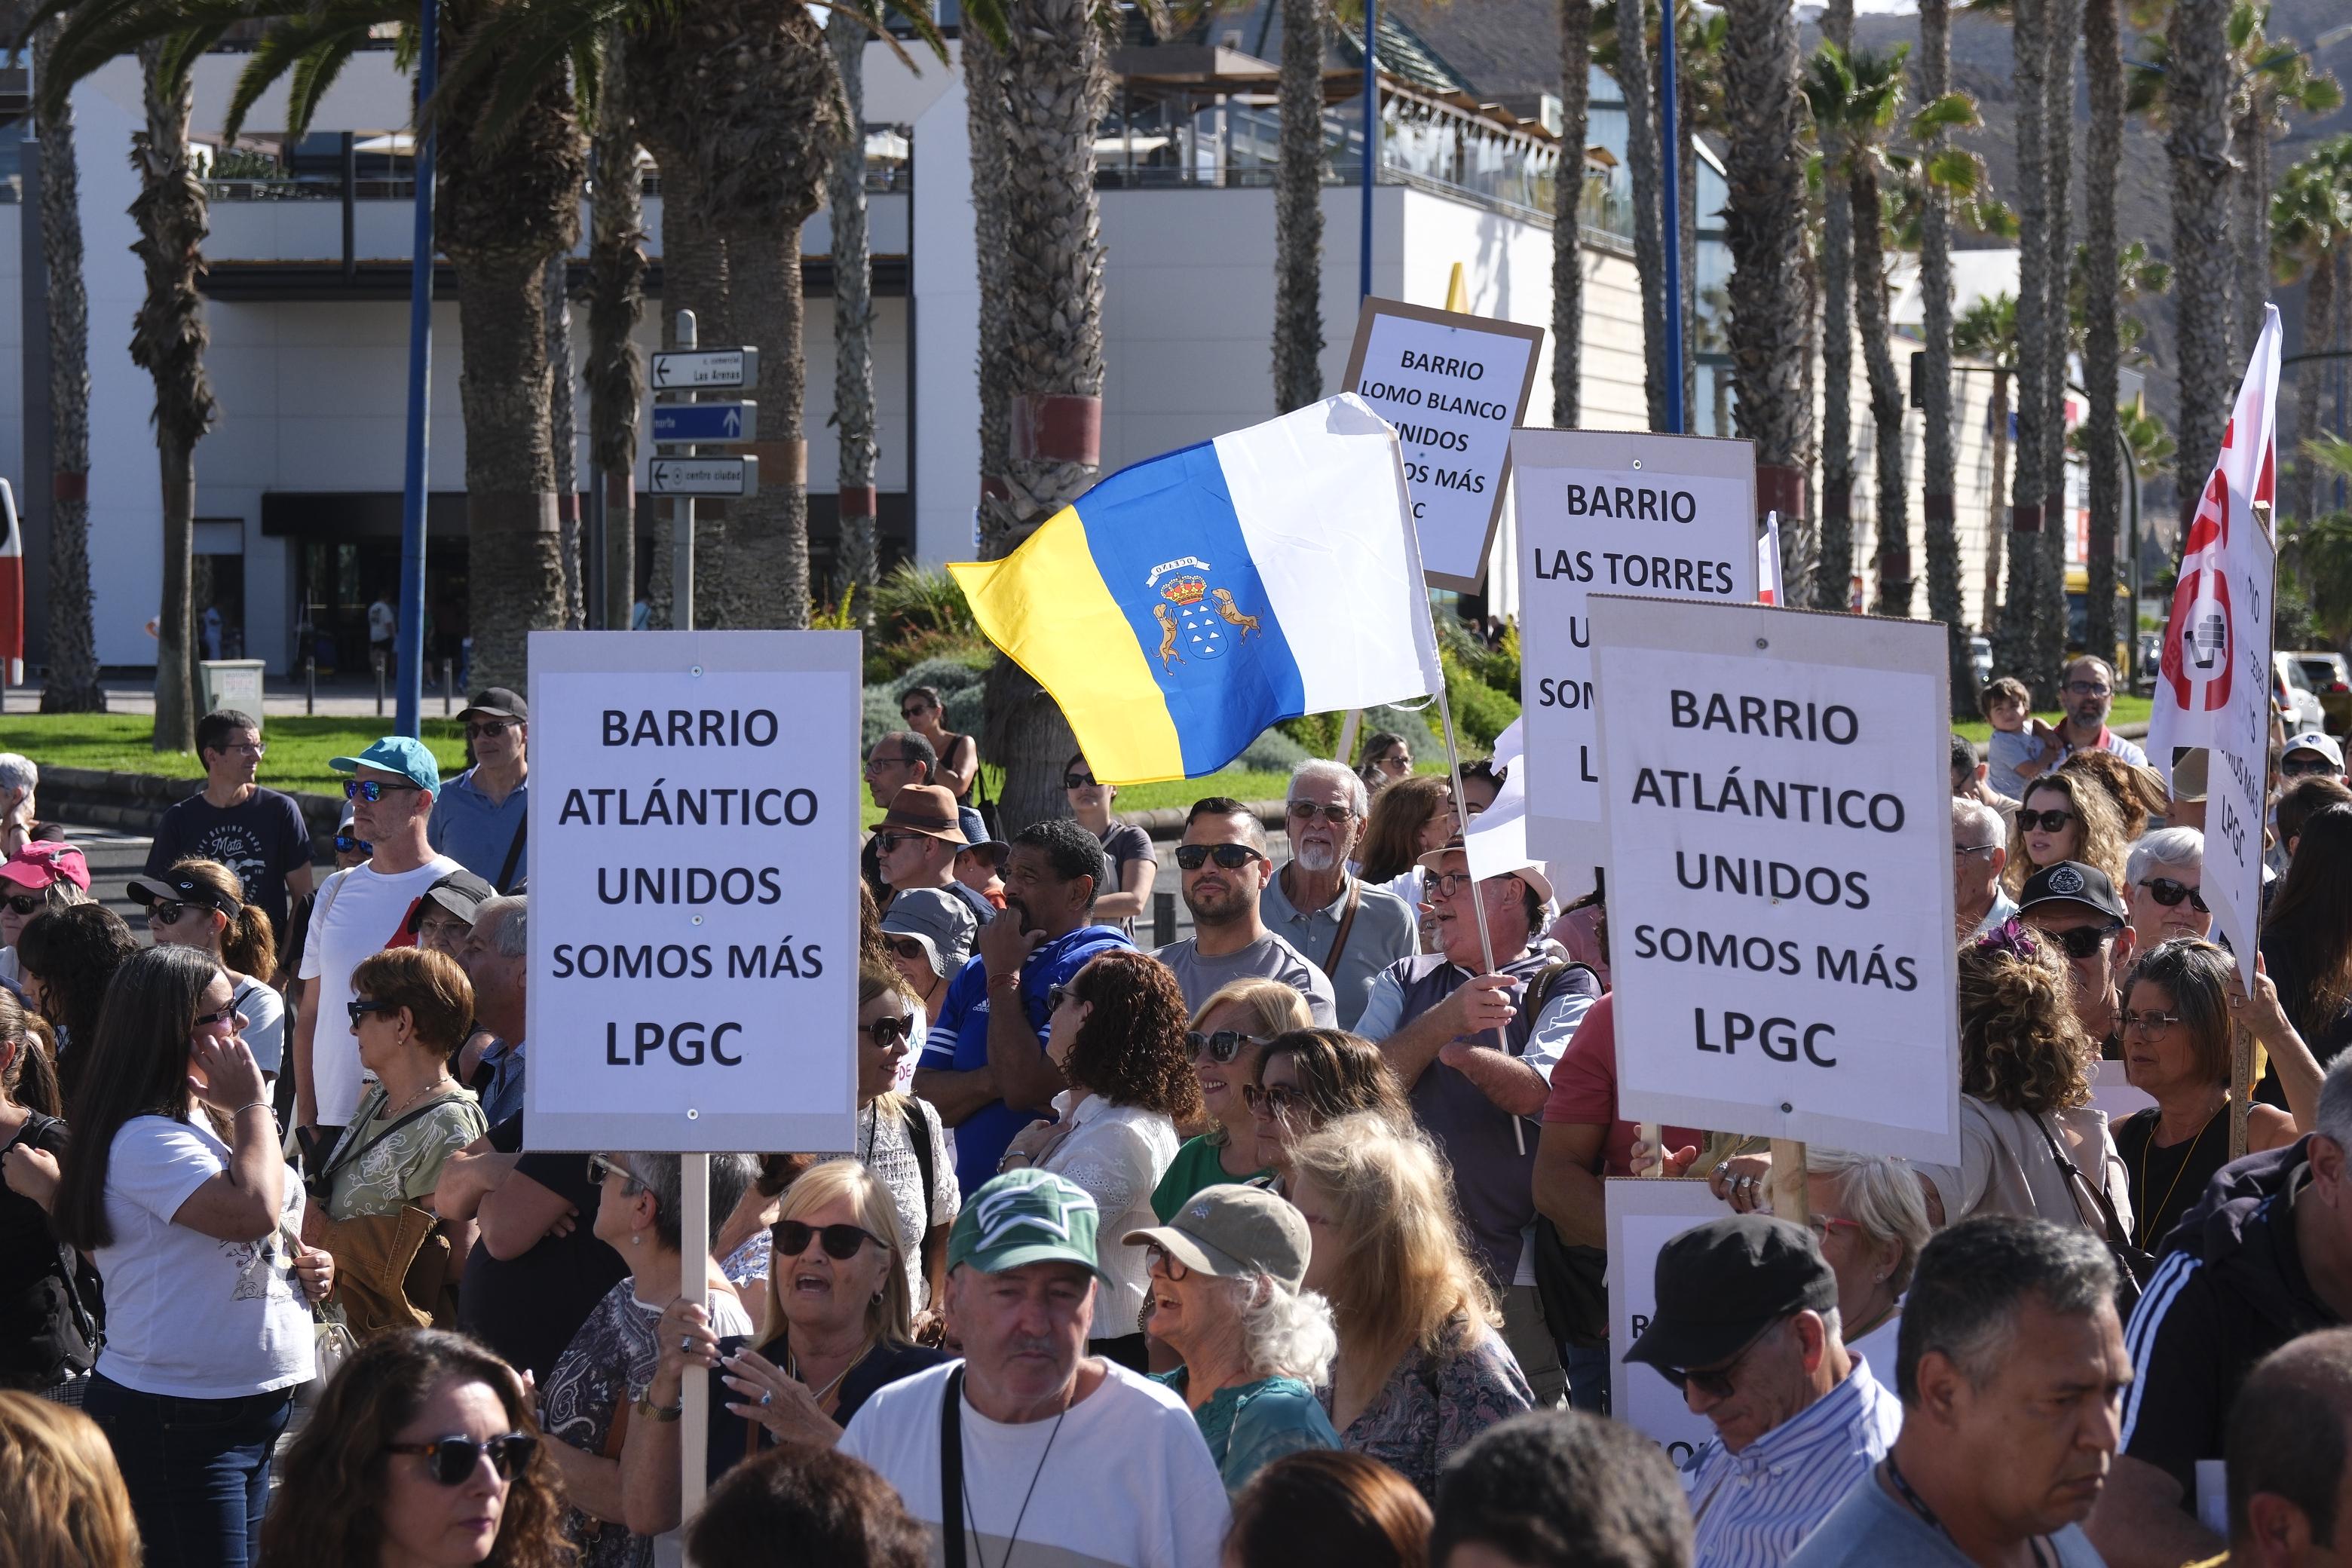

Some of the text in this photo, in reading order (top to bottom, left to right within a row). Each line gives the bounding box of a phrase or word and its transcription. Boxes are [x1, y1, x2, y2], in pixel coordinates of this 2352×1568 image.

[694, 369, 740, 382] Las Arenas
[1401, 350, 1484, 381] BARRIO
[1361, 380, 1507, 421] LOMO BLANCO
[1394, 421, 1469, 452] NIDOS
[685, 469, 742, 481] centro ciudad
[1435, 468, 1485, 494] MÁS
[1567, 484, 1696, 524] BARRIO
[1535, 547, 1733, 594] LAS TORRES
[602, 709, 779, 747] BARRIO
[1671, 689, 1859, 746] BARRIO
[559, 777, 818, 826] ATLÁNTICO
[1631, 766, 1905, 833] ATLÁNTICO
[2222, 794, 2245, 868] LPGC
[598, 867, 782, 905] UNIDOS
[1676, 850, 1870, 910] UNIDOS
[553, 935, 823, 979] SOMOS MÁS
[1634, 924, 1918, 999] SOMOS MÁS
[606, 1021, 743, 1067] LPGC
[1695, 1007, 1837, 1068] LPGC
